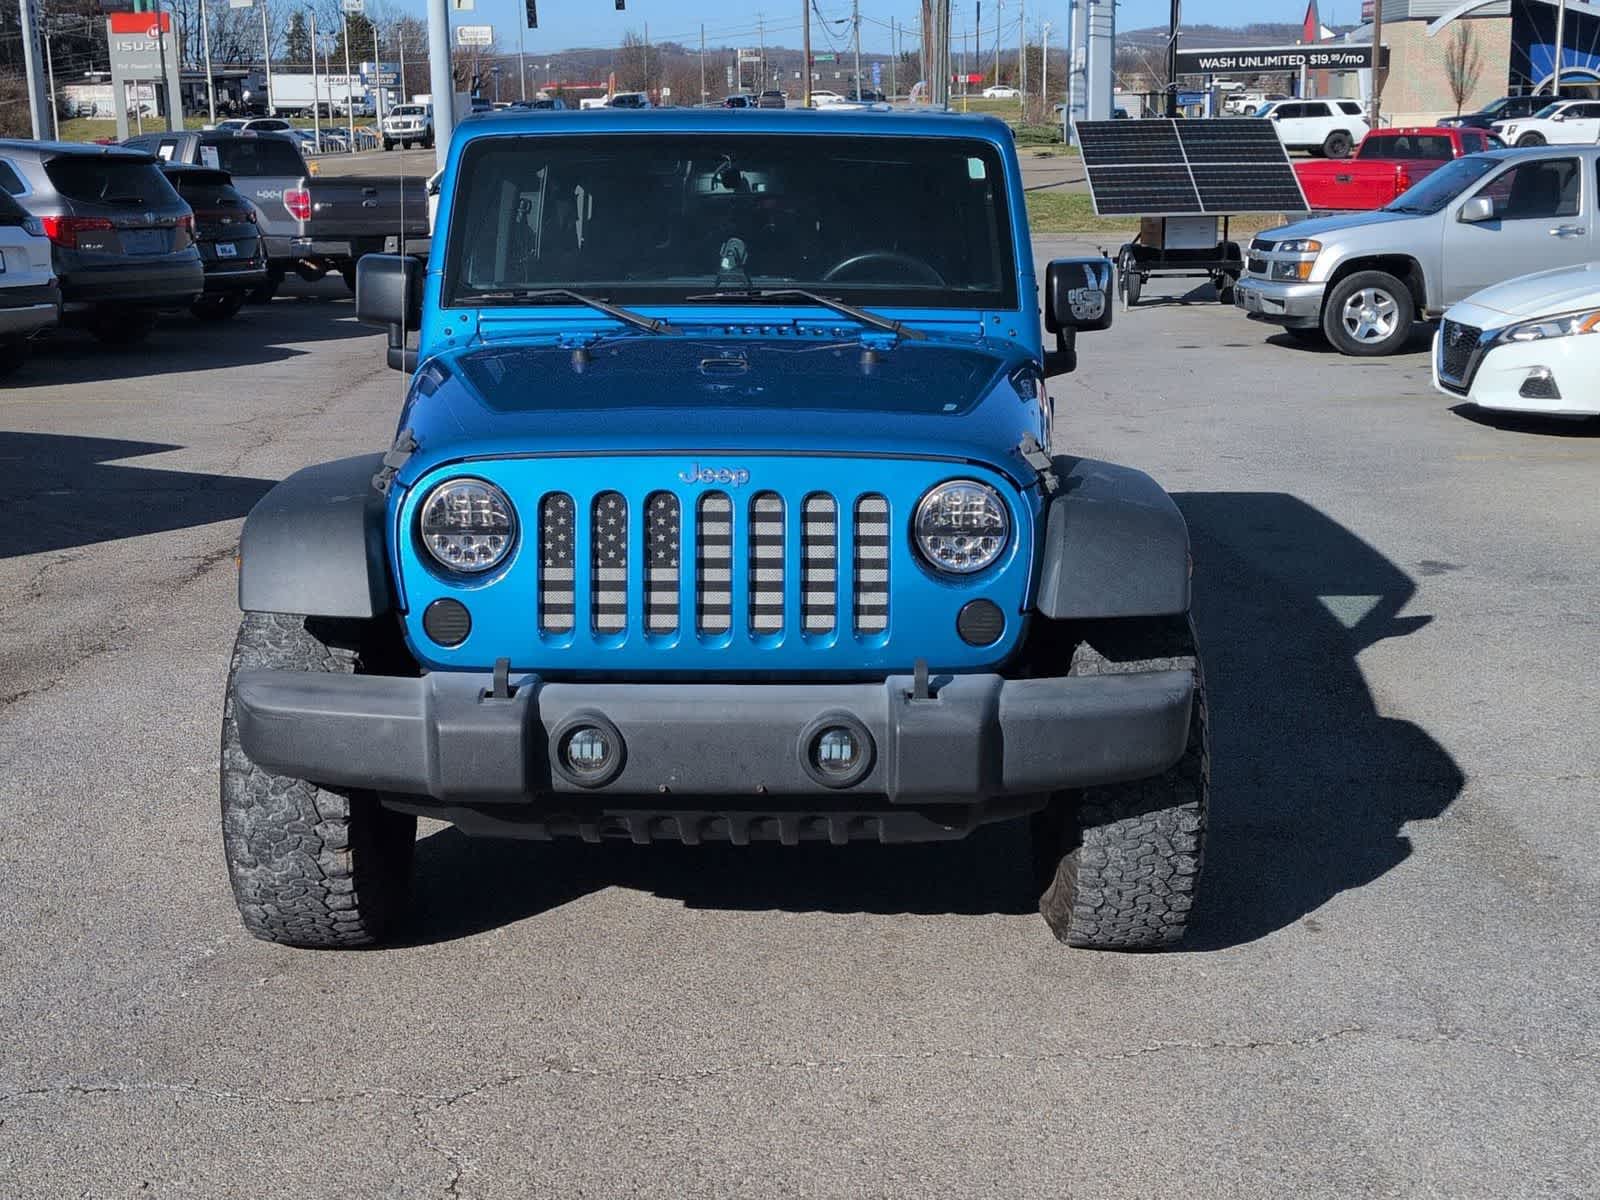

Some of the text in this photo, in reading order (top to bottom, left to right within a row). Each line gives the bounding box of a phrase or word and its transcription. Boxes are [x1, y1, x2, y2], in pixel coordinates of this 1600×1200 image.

[116, 40, 168, 52] ISUZU
[1199, 53, 1364, 69] WASH UNLIMITED $19.99/mo
[678, 463, 750, 488] Jeep
